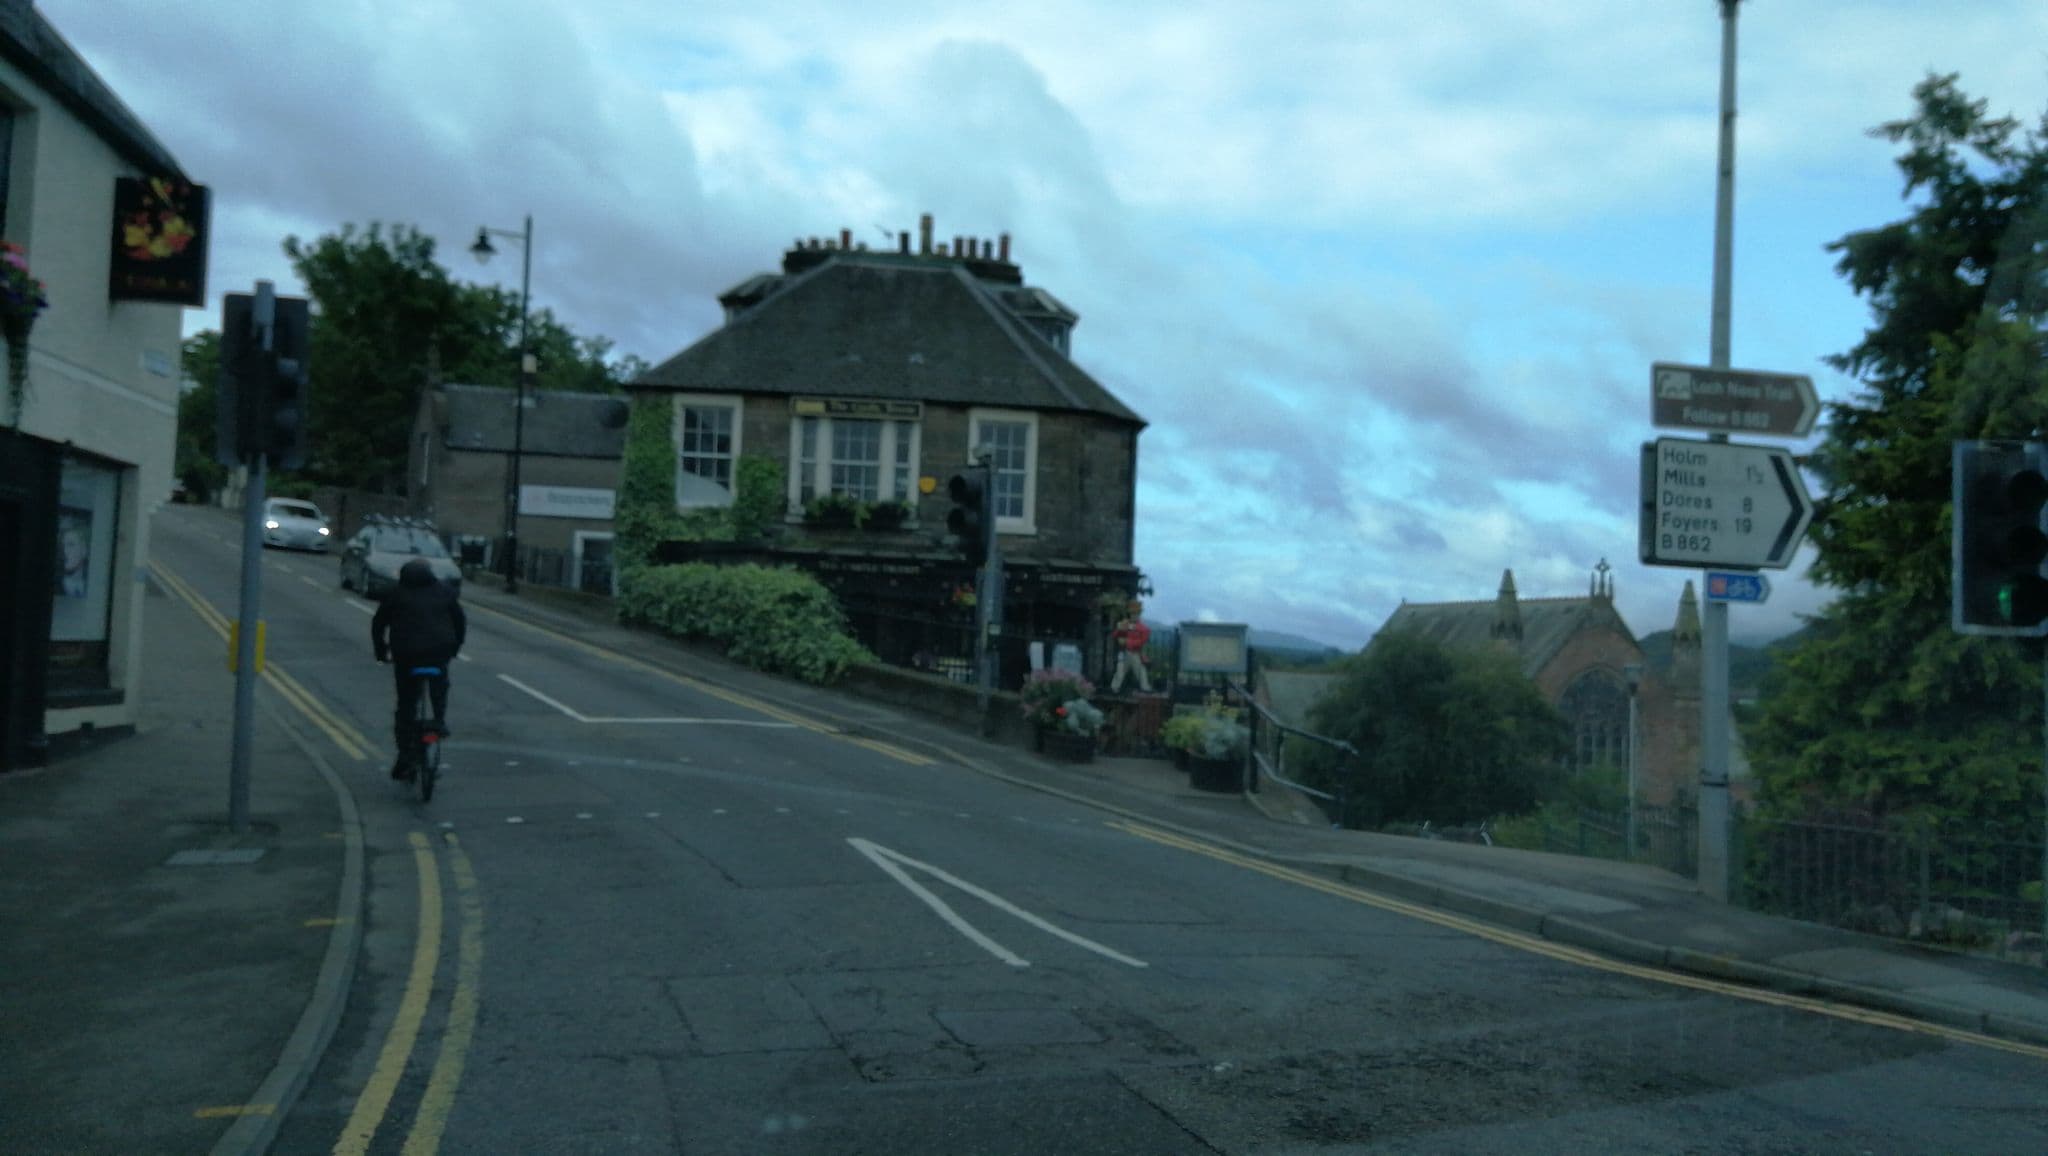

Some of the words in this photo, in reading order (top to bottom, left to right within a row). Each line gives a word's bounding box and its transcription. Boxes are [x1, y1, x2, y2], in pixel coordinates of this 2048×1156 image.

[1682, 406, 1727, 425] Follow
[1664, 447, 1707, 465] Holm
[1664, 469, 1705, 487] Mills
[1662, 491, 1712, 509] Dores
[1743, 497, 1753, 513] 8
[1662, 511, 1718, 532] Foyers
[1735, 518, 1753, 534] 19
[1662, 534, 1672, 549] B
[1677, 535, 1711, 551] 862
